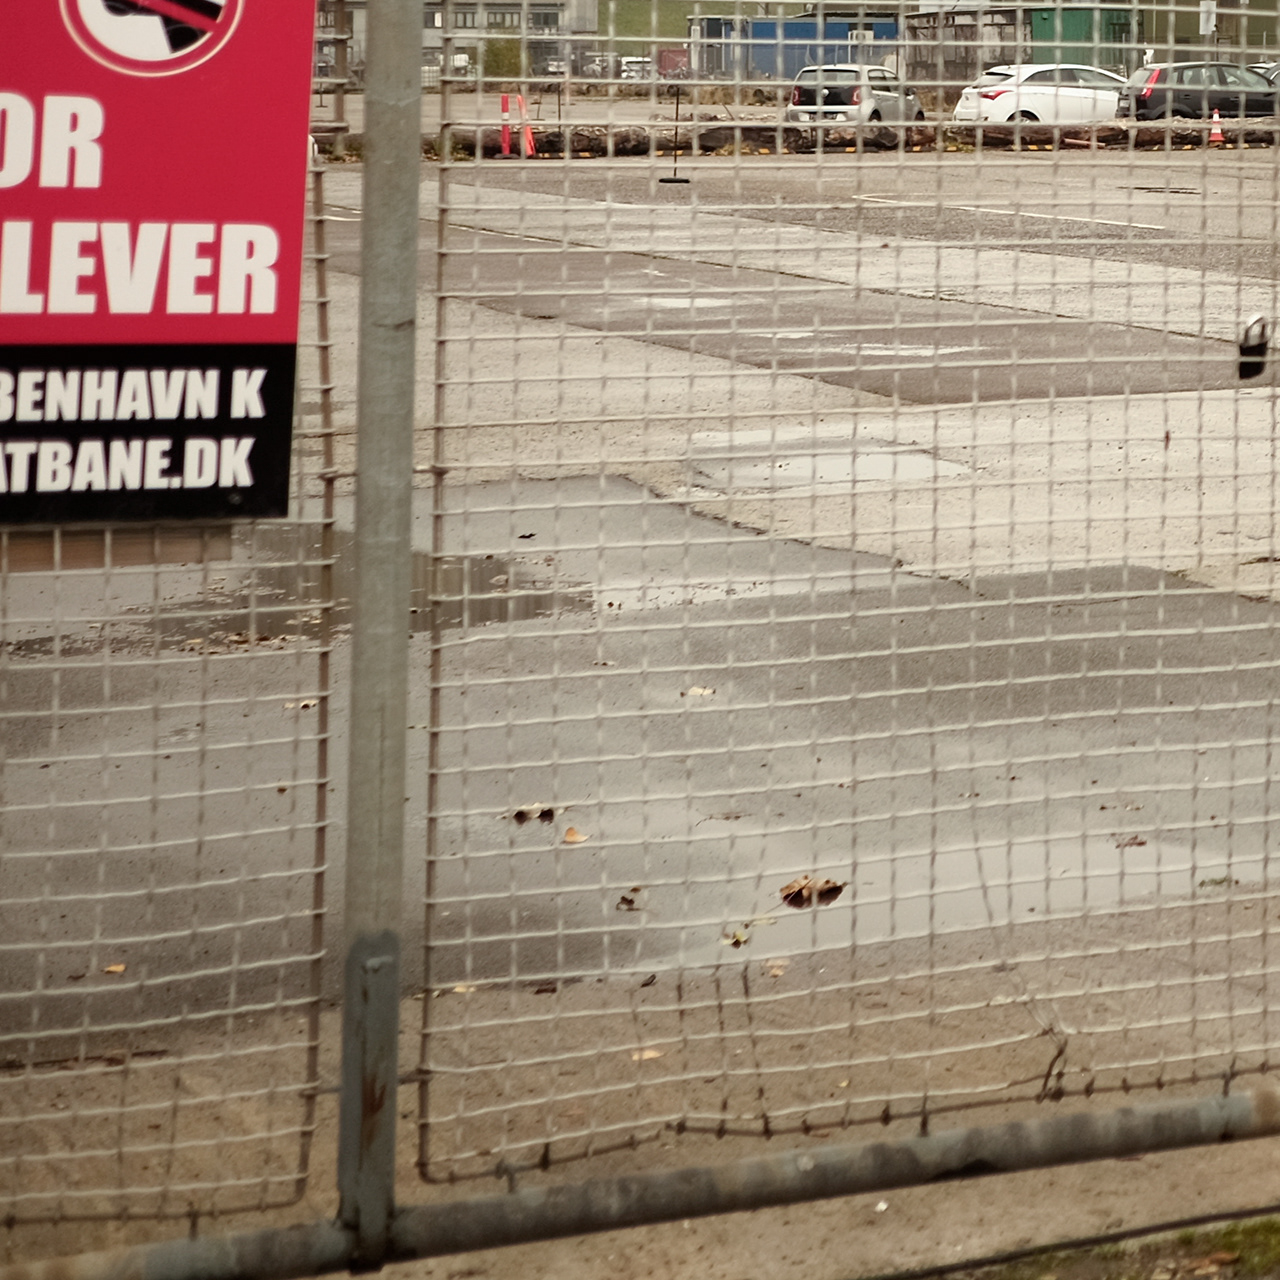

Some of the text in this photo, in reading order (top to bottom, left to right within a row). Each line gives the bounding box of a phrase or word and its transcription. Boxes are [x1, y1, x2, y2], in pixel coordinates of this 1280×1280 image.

[0, 220, 280, 315] LEVER
[230, 368, 268, 420] K
[0, 437, 256, 494] TBANE.DK
